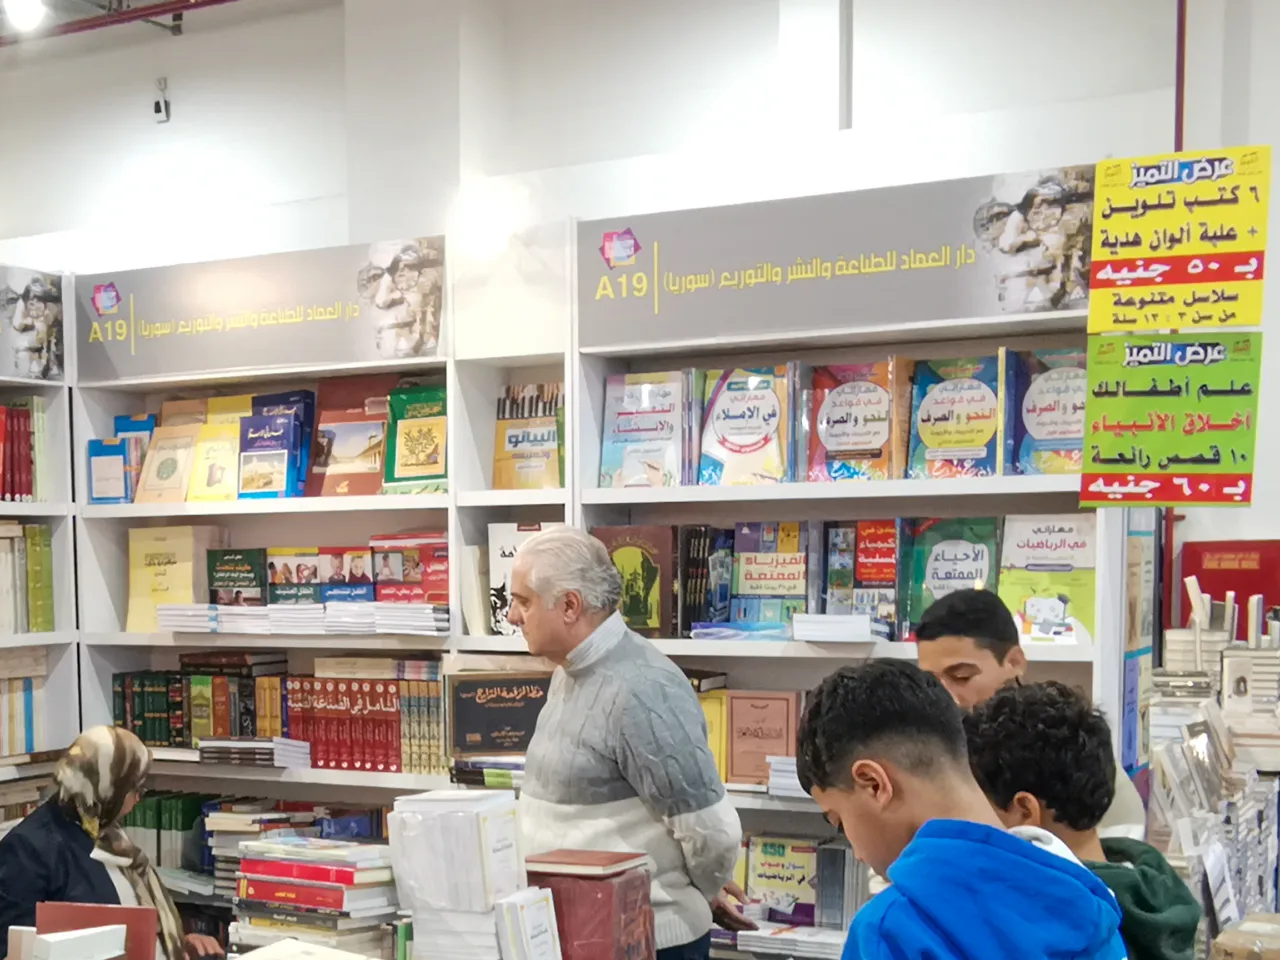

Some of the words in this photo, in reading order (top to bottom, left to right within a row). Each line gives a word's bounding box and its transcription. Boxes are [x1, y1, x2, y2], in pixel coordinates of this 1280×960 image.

[1129, 160, 1180, 190] التميز
[1181, 157, 1235, 184] عرض
[1101, 190, 1176, 219] تلوين
[1183, 185, 1241, 213] كتب
[1100, 228, 1142, 256] هدية
[1149, 222, 1191, 251] ألوان
[1199, 222, 1238, 249] علبة
[836, 250, 897, 277] للطباعة
[901, 245, 951, 269] العماد
[955, 243, 976, 270] دار
[1187, 258, 1220, 274] ٥٠
[663, 266, 715, 295] (سوريا)
[718, 263, 782, 289] والتوزيع
[786, 255, 831, 284] والنشر
[1096, 260, 1171, 285] جنيه
[595, 272, 648, 301] A19
[1183, 289, 1239, 307] سلاسل
[306, 301, 342, 321] العماد
[1112, 291, 1175, 310] متنوعة
[177, 312, 222, 336] والتوزيع
[225, 310, 258, 332] والنشر
[260, 304, 304, 327] للطباعة
[344, 304, 360, 322] دار
[1218, 309, 1237, 323] من
[89, 319, 128, 343] A19
[1122, 342, 1172, 366] التميز
[1174, 343, 1226, 365] عرض
[1092, 376, 1191, 399] أطفالك
[1197, 379, 1254, 403] علم
[762, 404, 778, 425] في
[862, 409, 889, 423] لنحو
[1091, 445, 1152, 469] رائعة
[1158, 445, 1221, 470] قصص
[1087, 474, 1161, 499] جنيه
[1173, 476, 1210, 496] ٦٠
[858, 538, 896, 551] كيمياء
[1067, 539, 1087, 551] في
